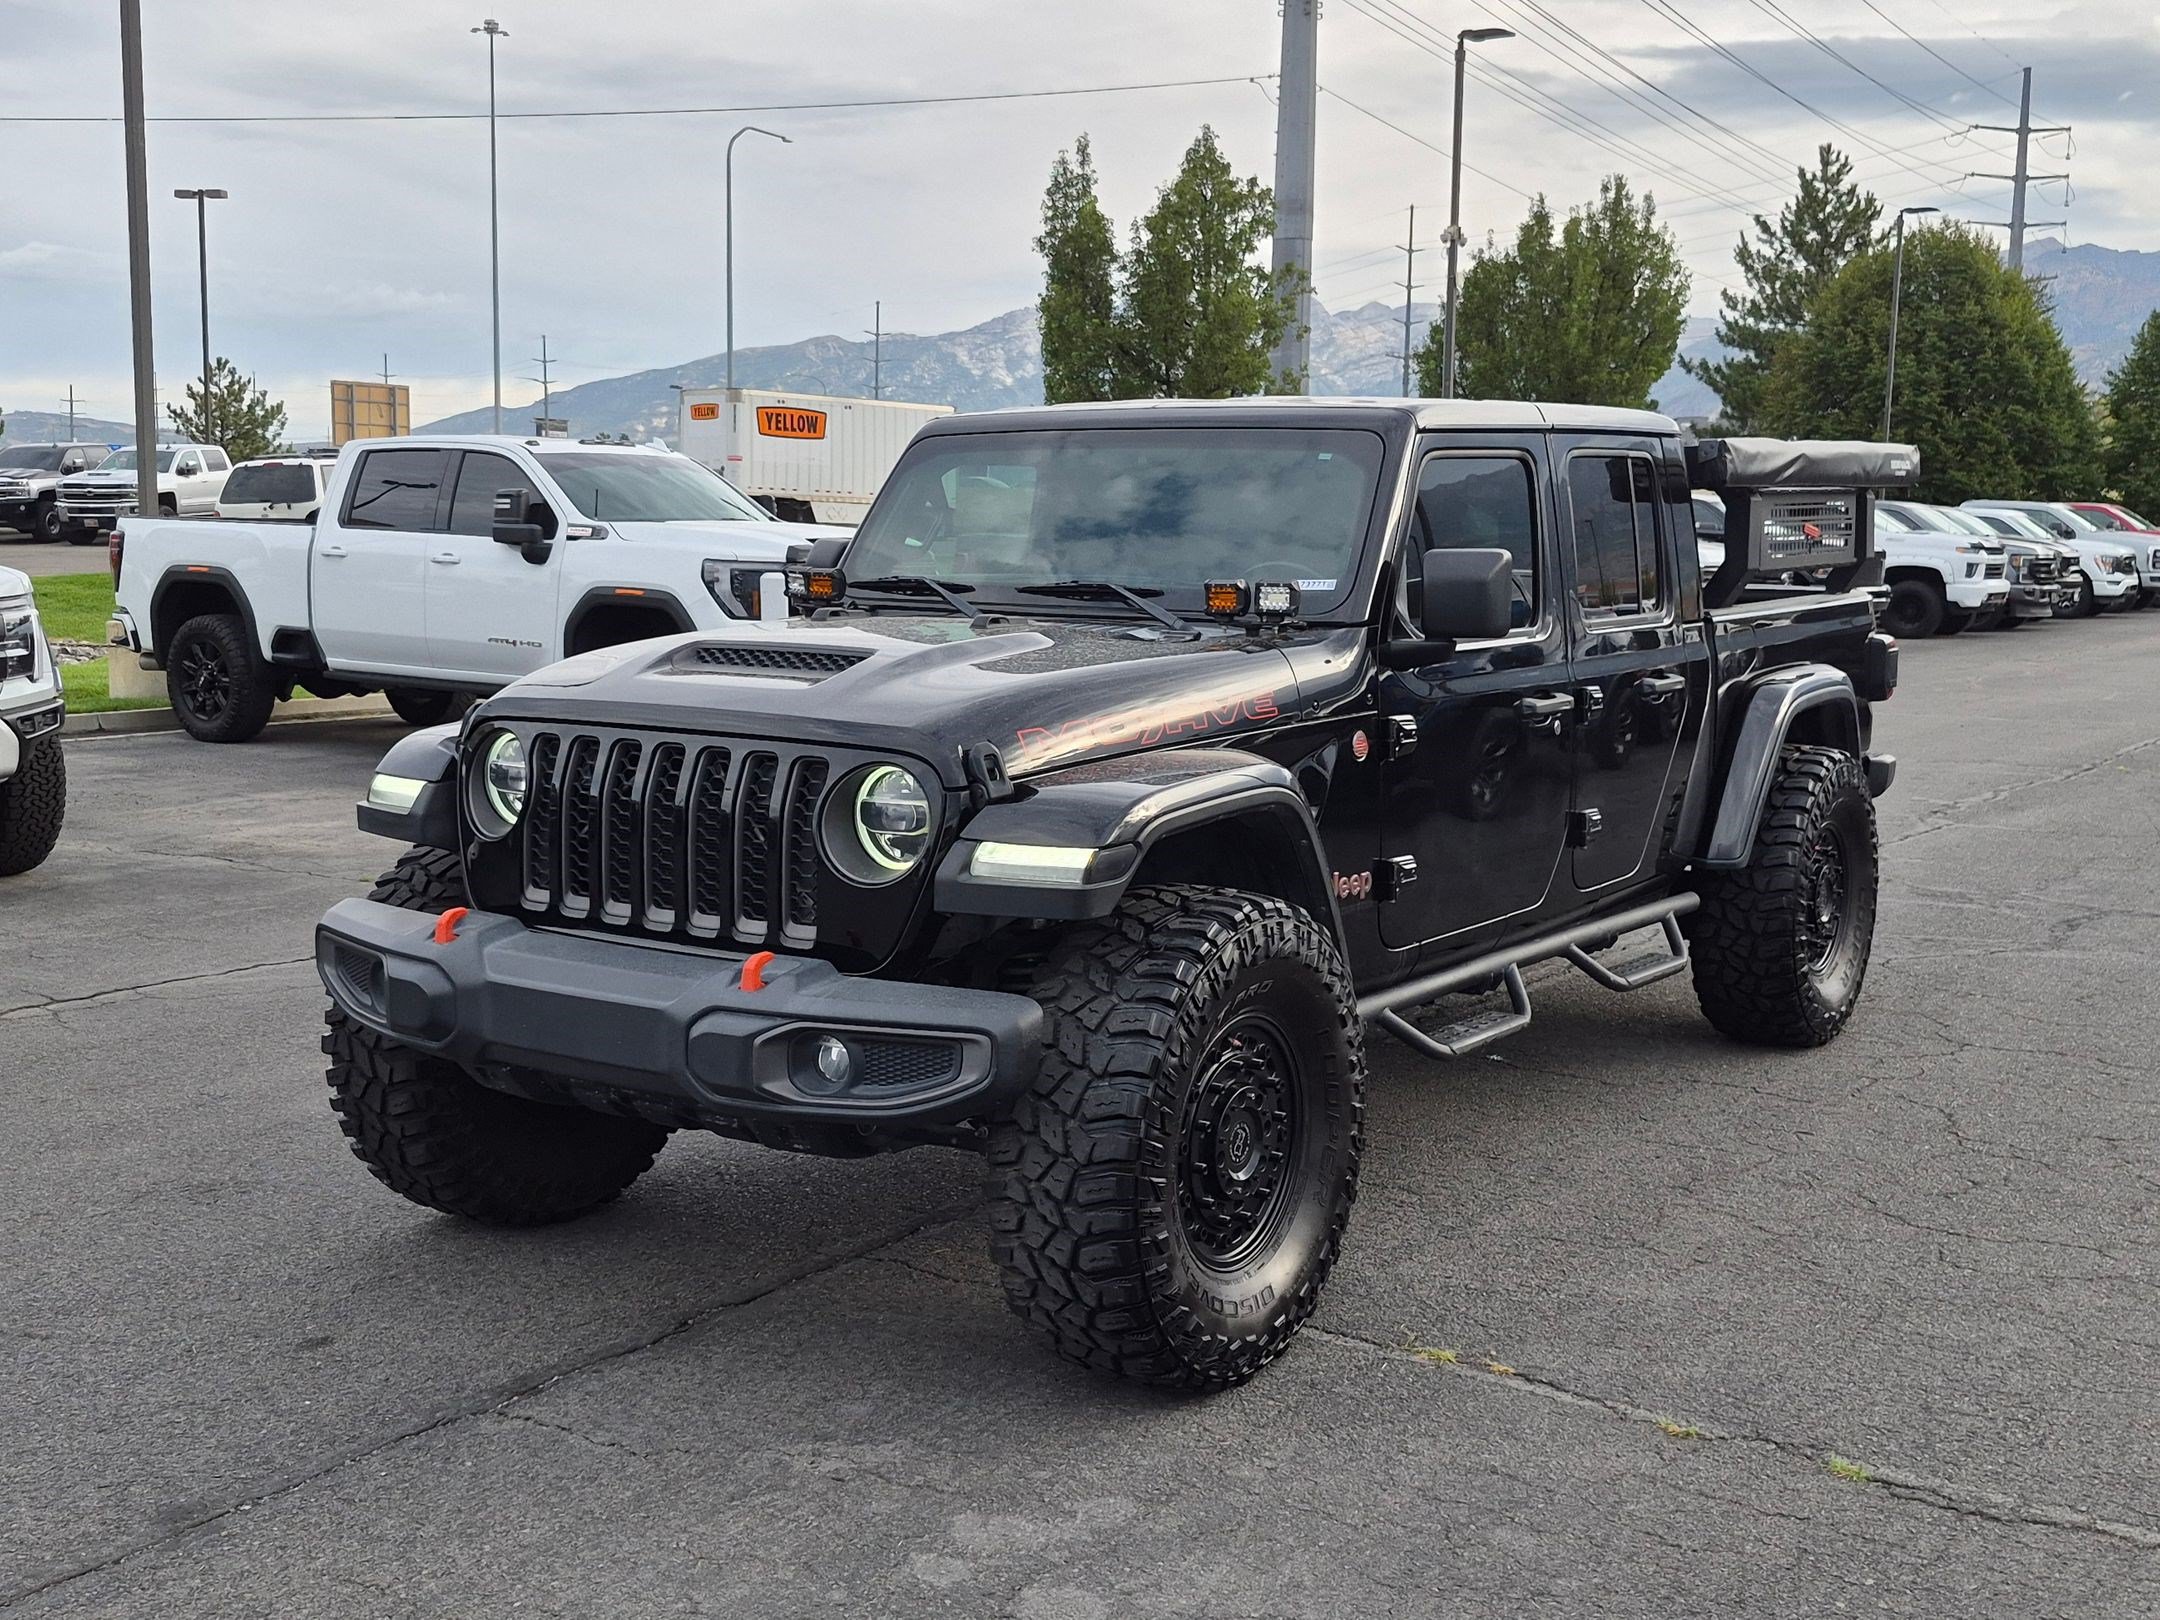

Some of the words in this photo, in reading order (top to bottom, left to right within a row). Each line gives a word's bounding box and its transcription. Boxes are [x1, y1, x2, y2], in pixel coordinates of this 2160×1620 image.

[693, 406, 716, 417] YELLOW
[765, 412, 819, 434] YELLOW
[1016, 690, 1279, 758] MOJAVE
[1332, 870, 1373, 900] Jeep
